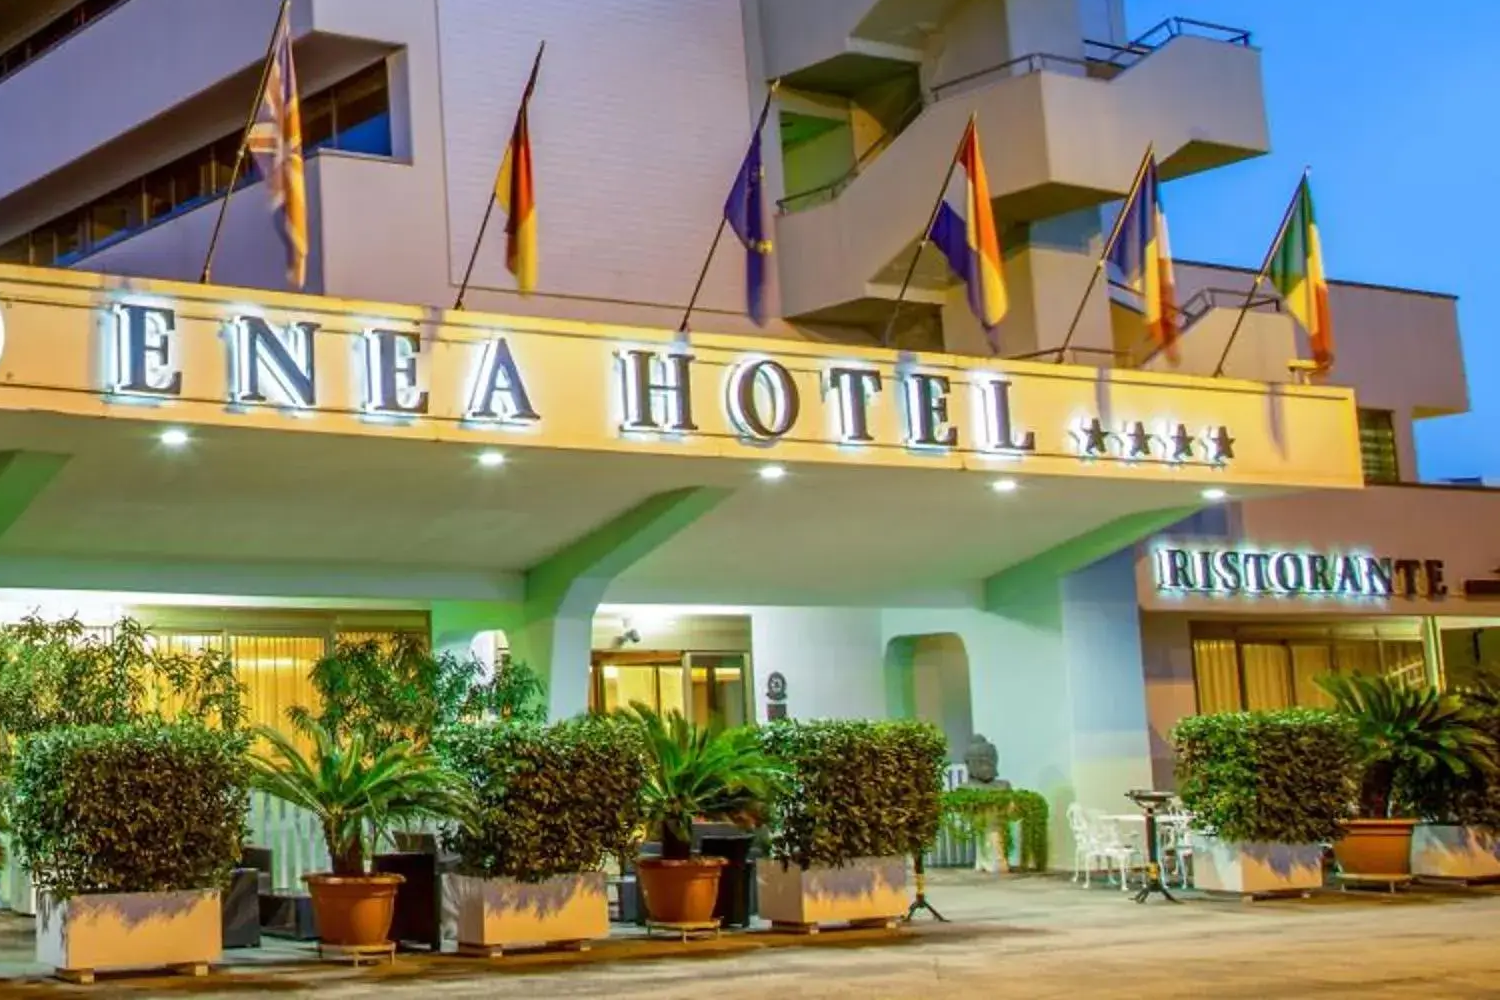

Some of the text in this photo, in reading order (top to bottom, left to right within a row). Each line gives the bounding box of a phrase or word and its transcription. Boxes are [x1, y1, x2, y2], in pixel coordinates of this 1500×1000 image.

[110, 301, 1036, 455] ENEA HOTEL
[1155, 547, 1449, 601] RISTORANTE
